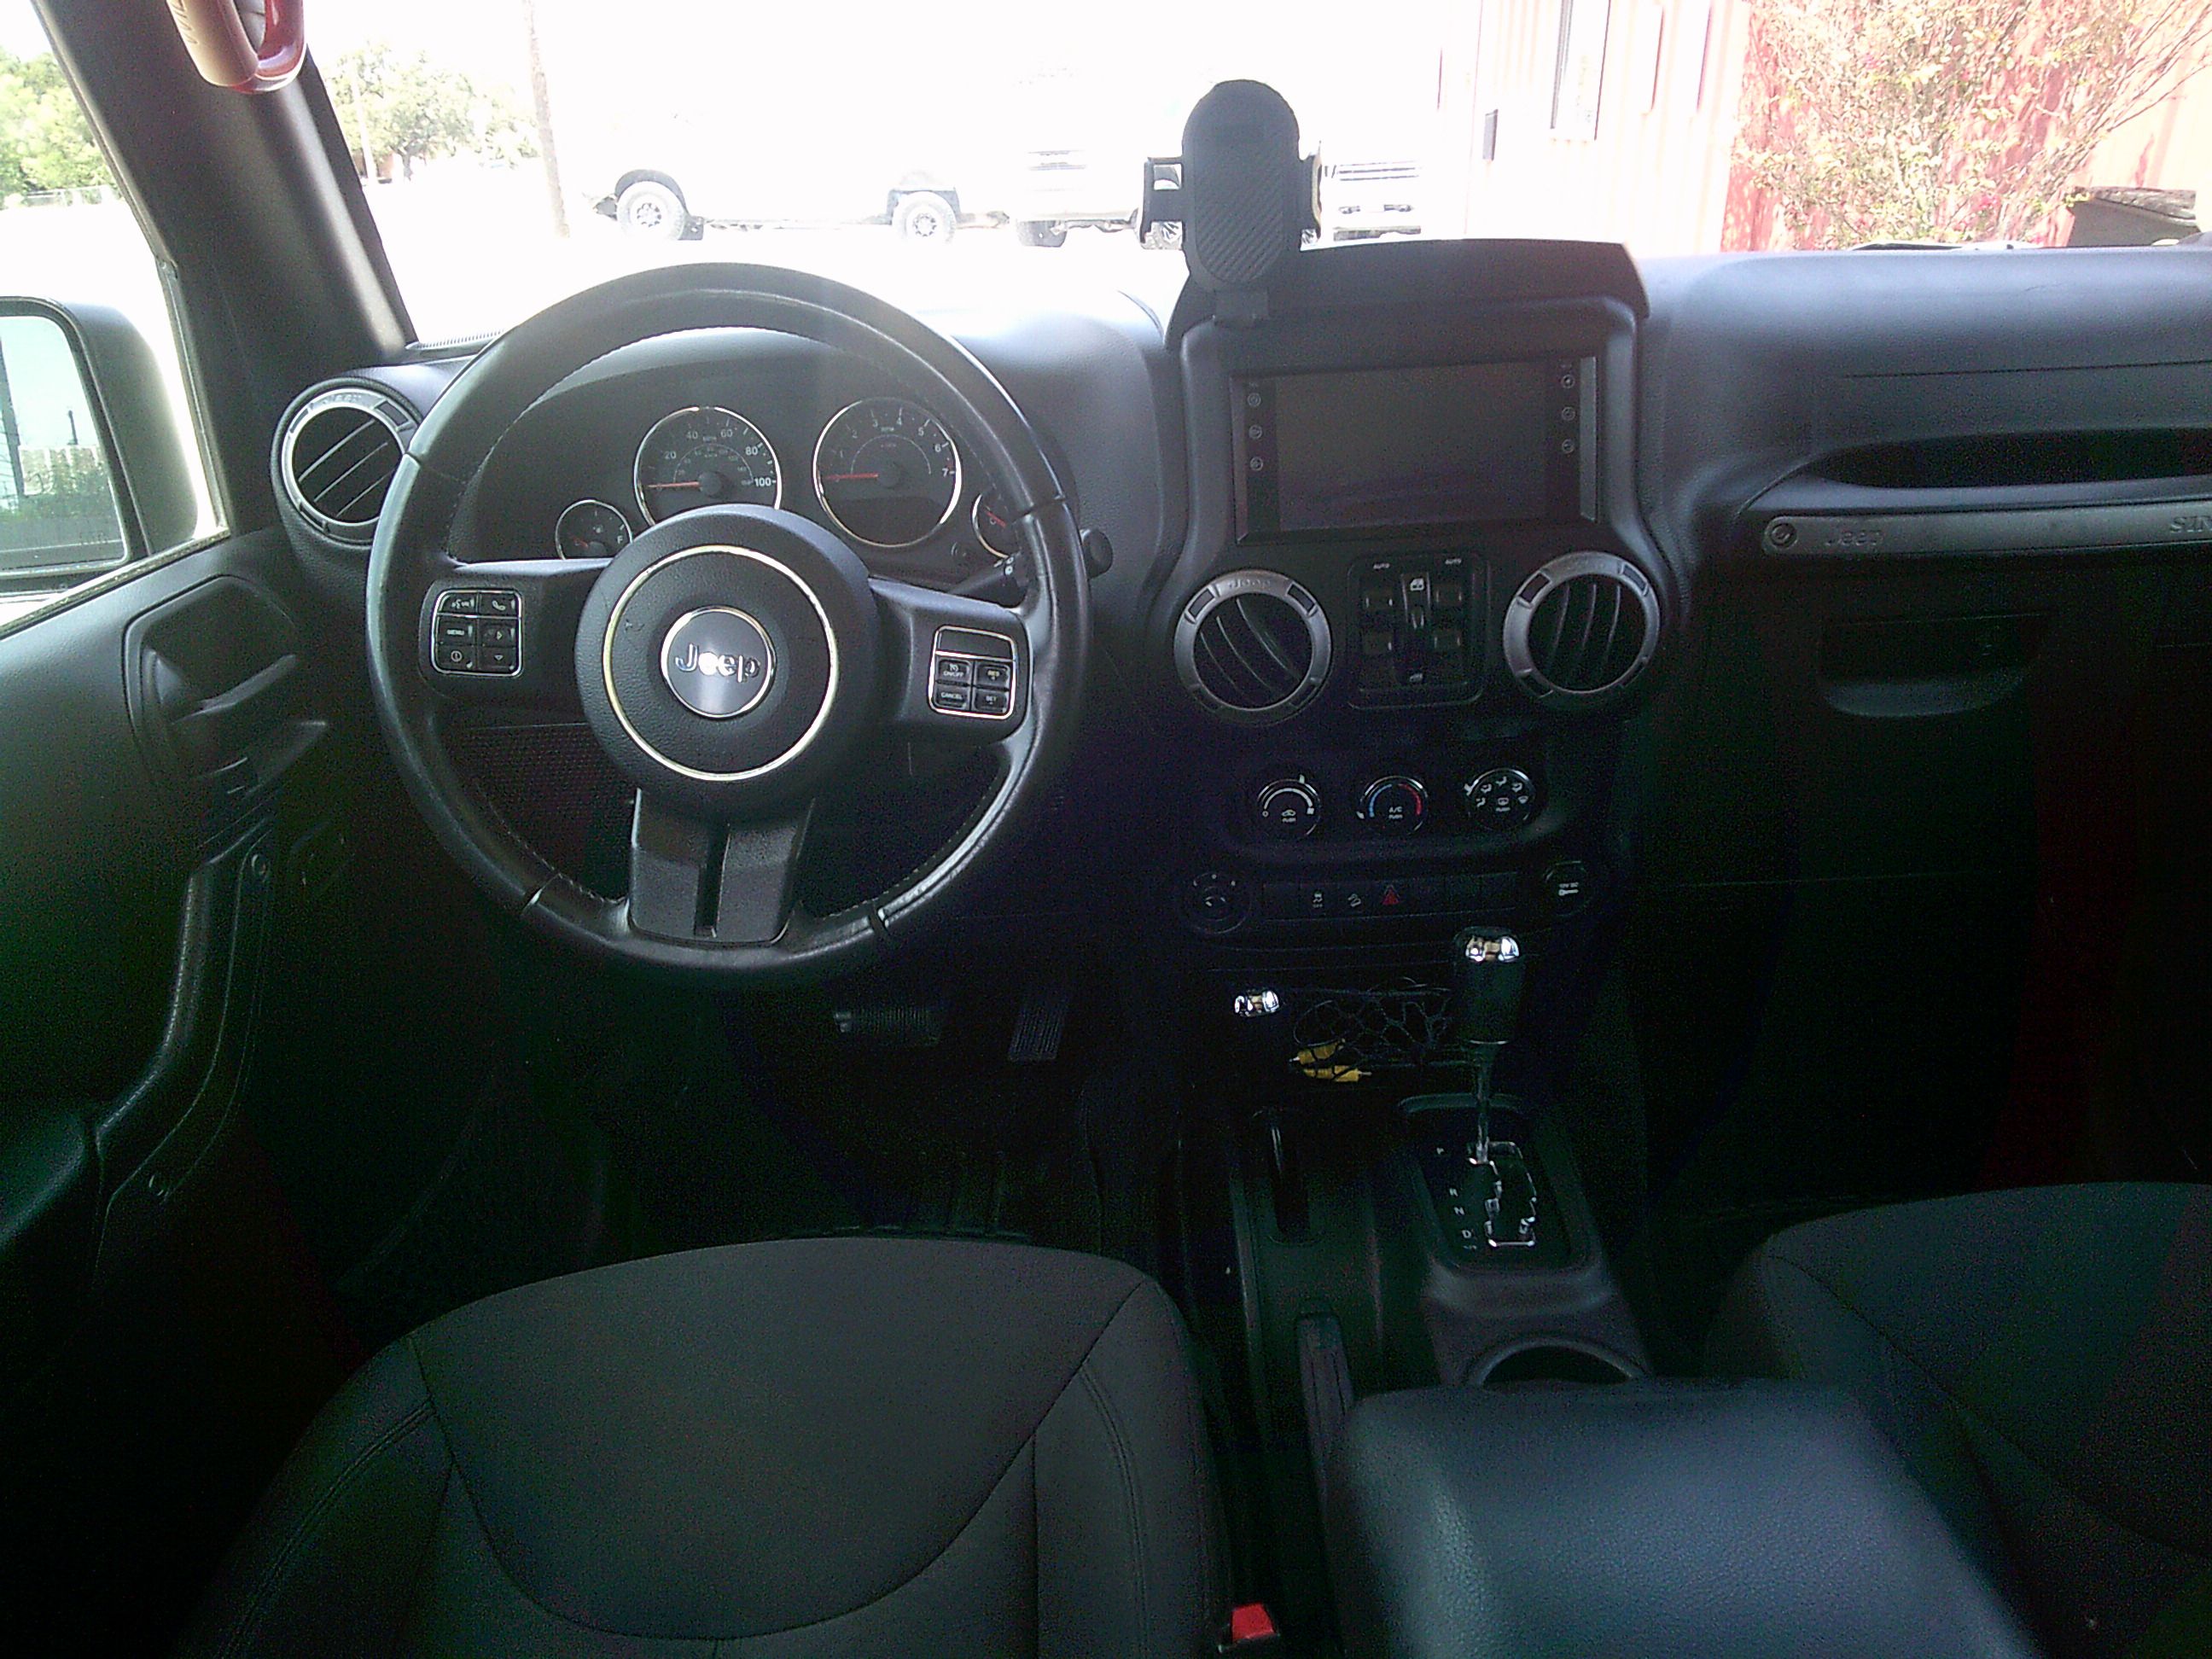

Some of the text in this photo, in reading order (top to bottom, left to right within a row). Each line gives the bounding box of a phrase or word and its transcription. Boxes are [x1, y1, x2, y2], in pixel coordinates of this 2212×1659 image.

[871, 418, 879, 428] 3
[895, 417, 903, 426] 4
[686, 430, 698, 439] 40
[720, 428, 733, 438] 60
[852, 429, 858, 439] 2
[917, 427, 924, 437] 5
[745, 445, 759, 456] 80
[934, 444, 941, 453] 6
[664, 451, 677, 460] 20
[942, 468, 950, 478] 7
[754, 477, 771, 487] 100
[616, 535, 623, 544] F
[1825, 527, 1883, 551] Jeep
[1229, 579, 1272, 590] Jeep
[674, 642, 761, 684] Jeep
[940, 691, 963, 701] CANCEL
[1453, 1206, 1465, 1216] N
[1461, 1229, 1472, 1239] D
